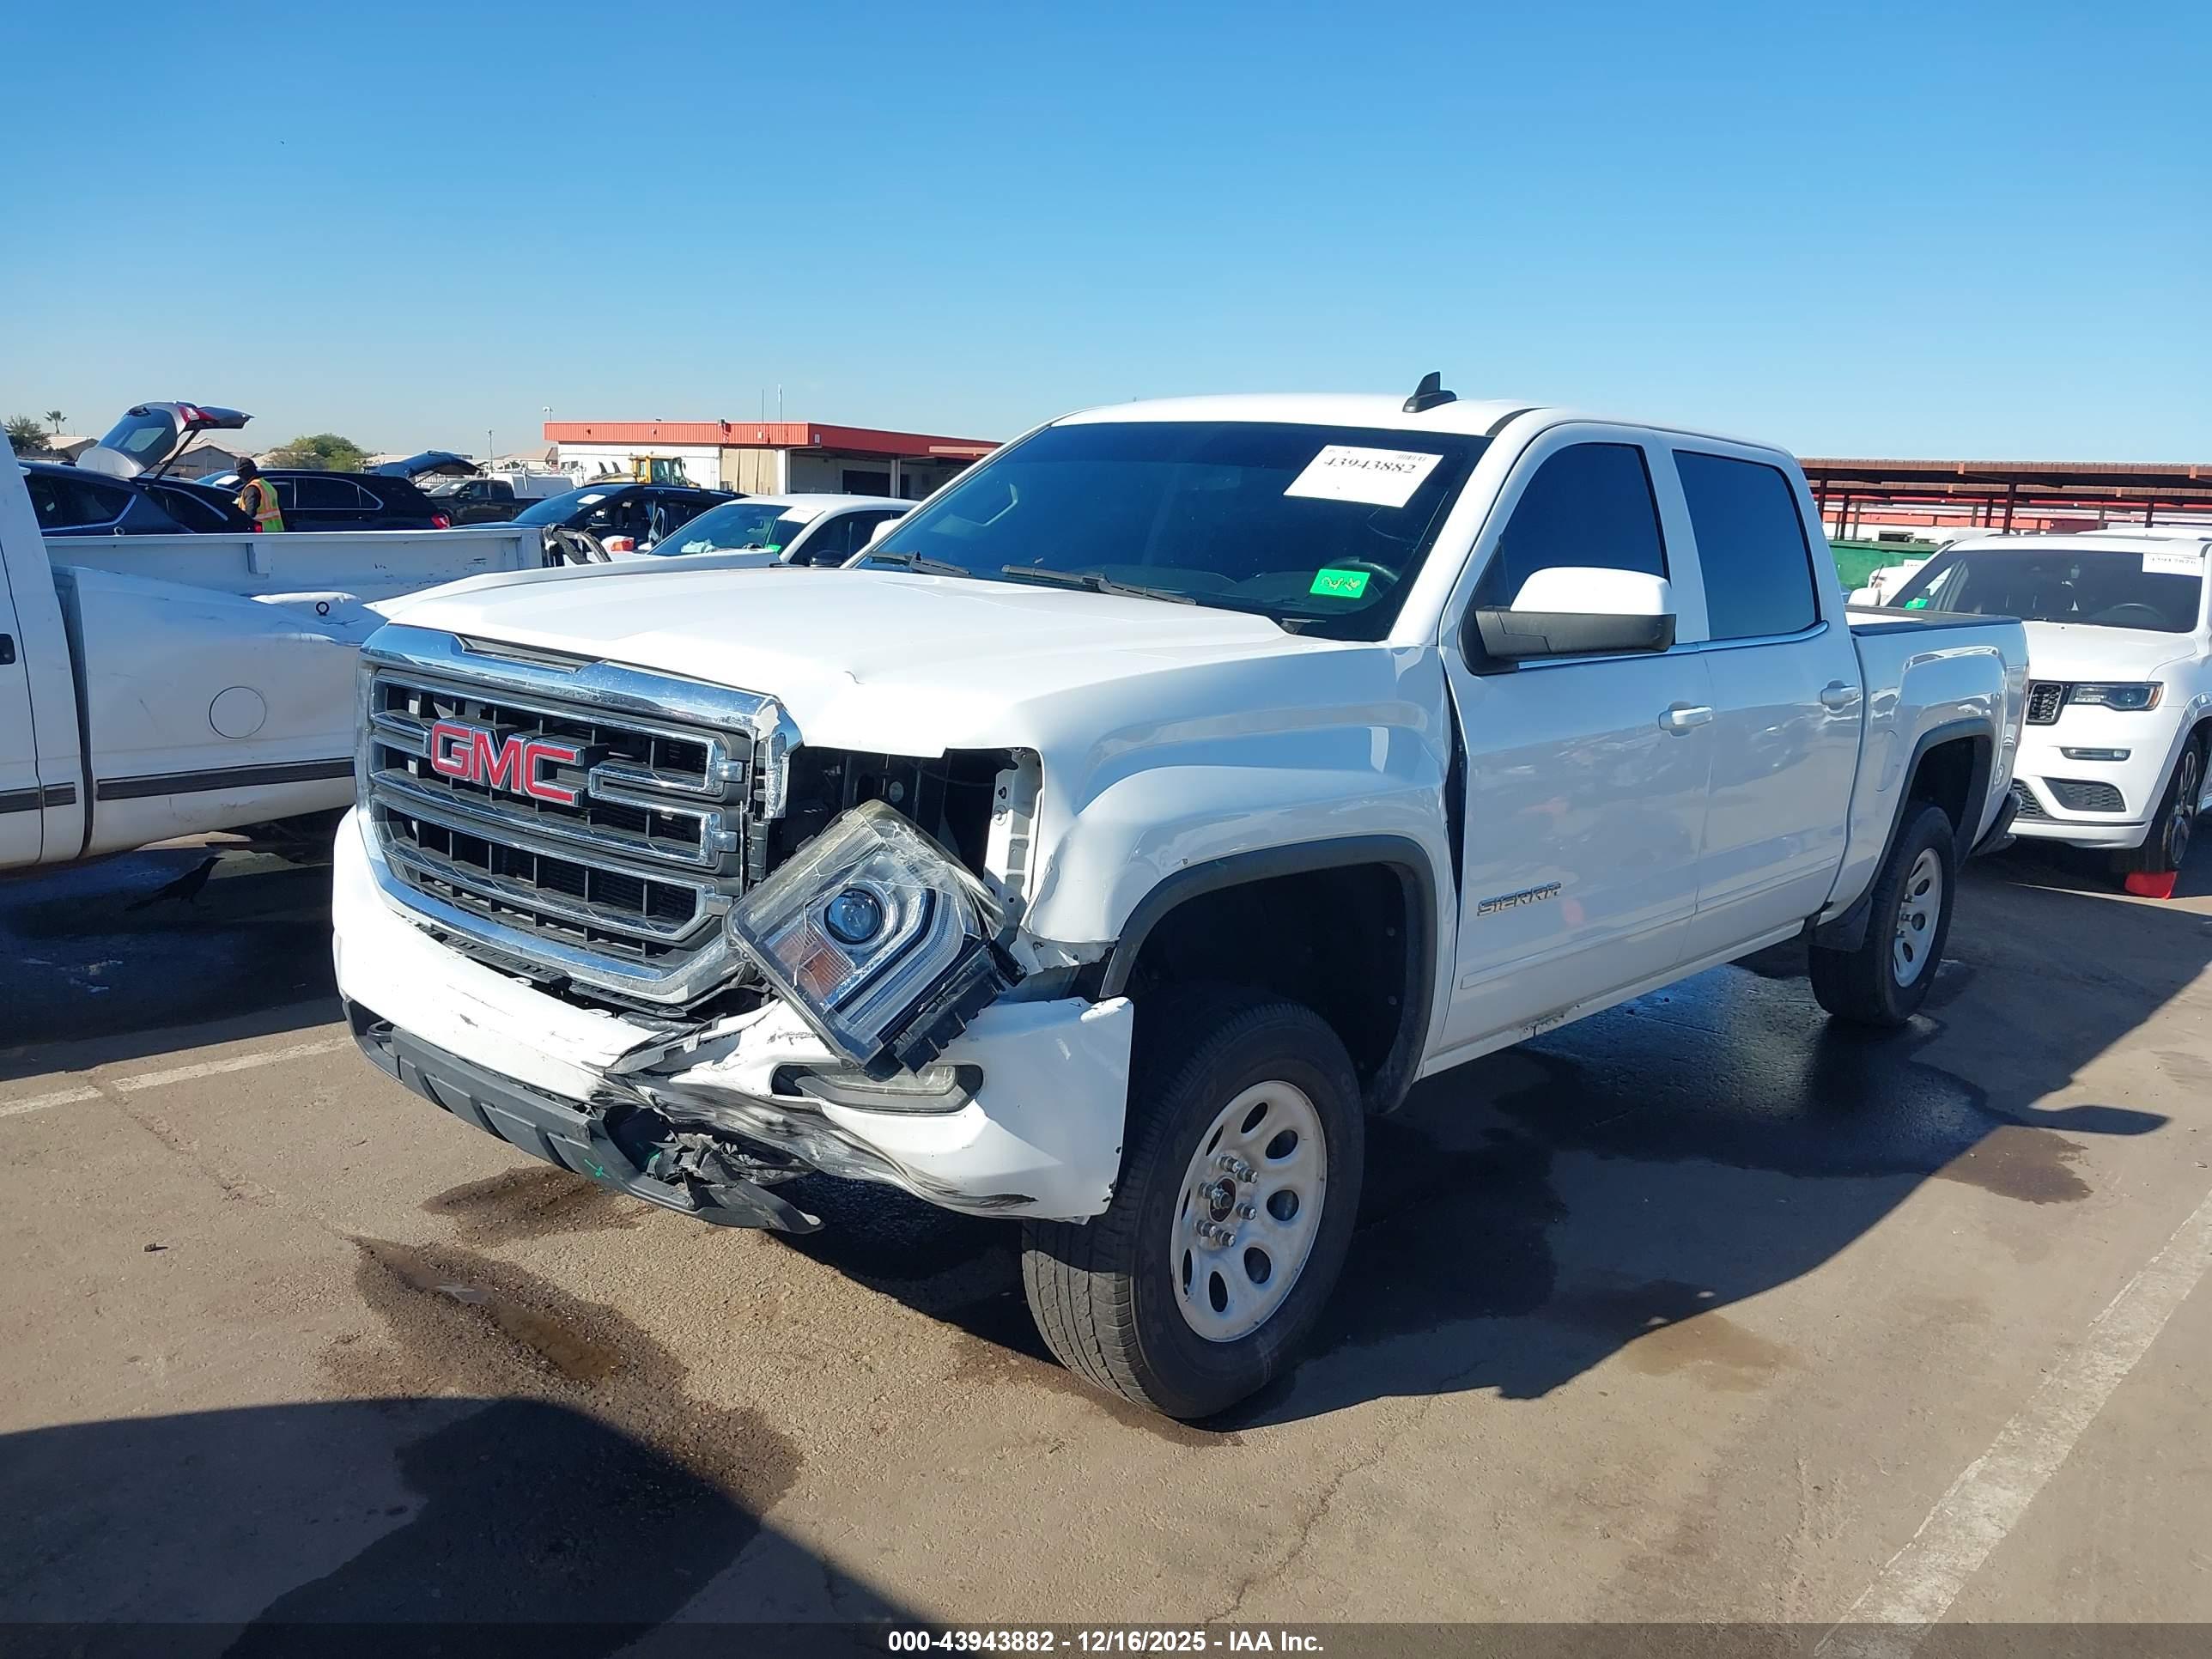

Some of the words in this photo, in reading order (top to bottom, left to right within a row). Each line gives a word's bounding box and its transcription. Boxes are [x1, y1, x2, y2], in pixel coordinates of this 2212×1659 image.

[1323, 457, 1417, 474] 43943882
[431, 719, 585, 807] GMC
[1477, 881, 1562, 916] SIERRA
